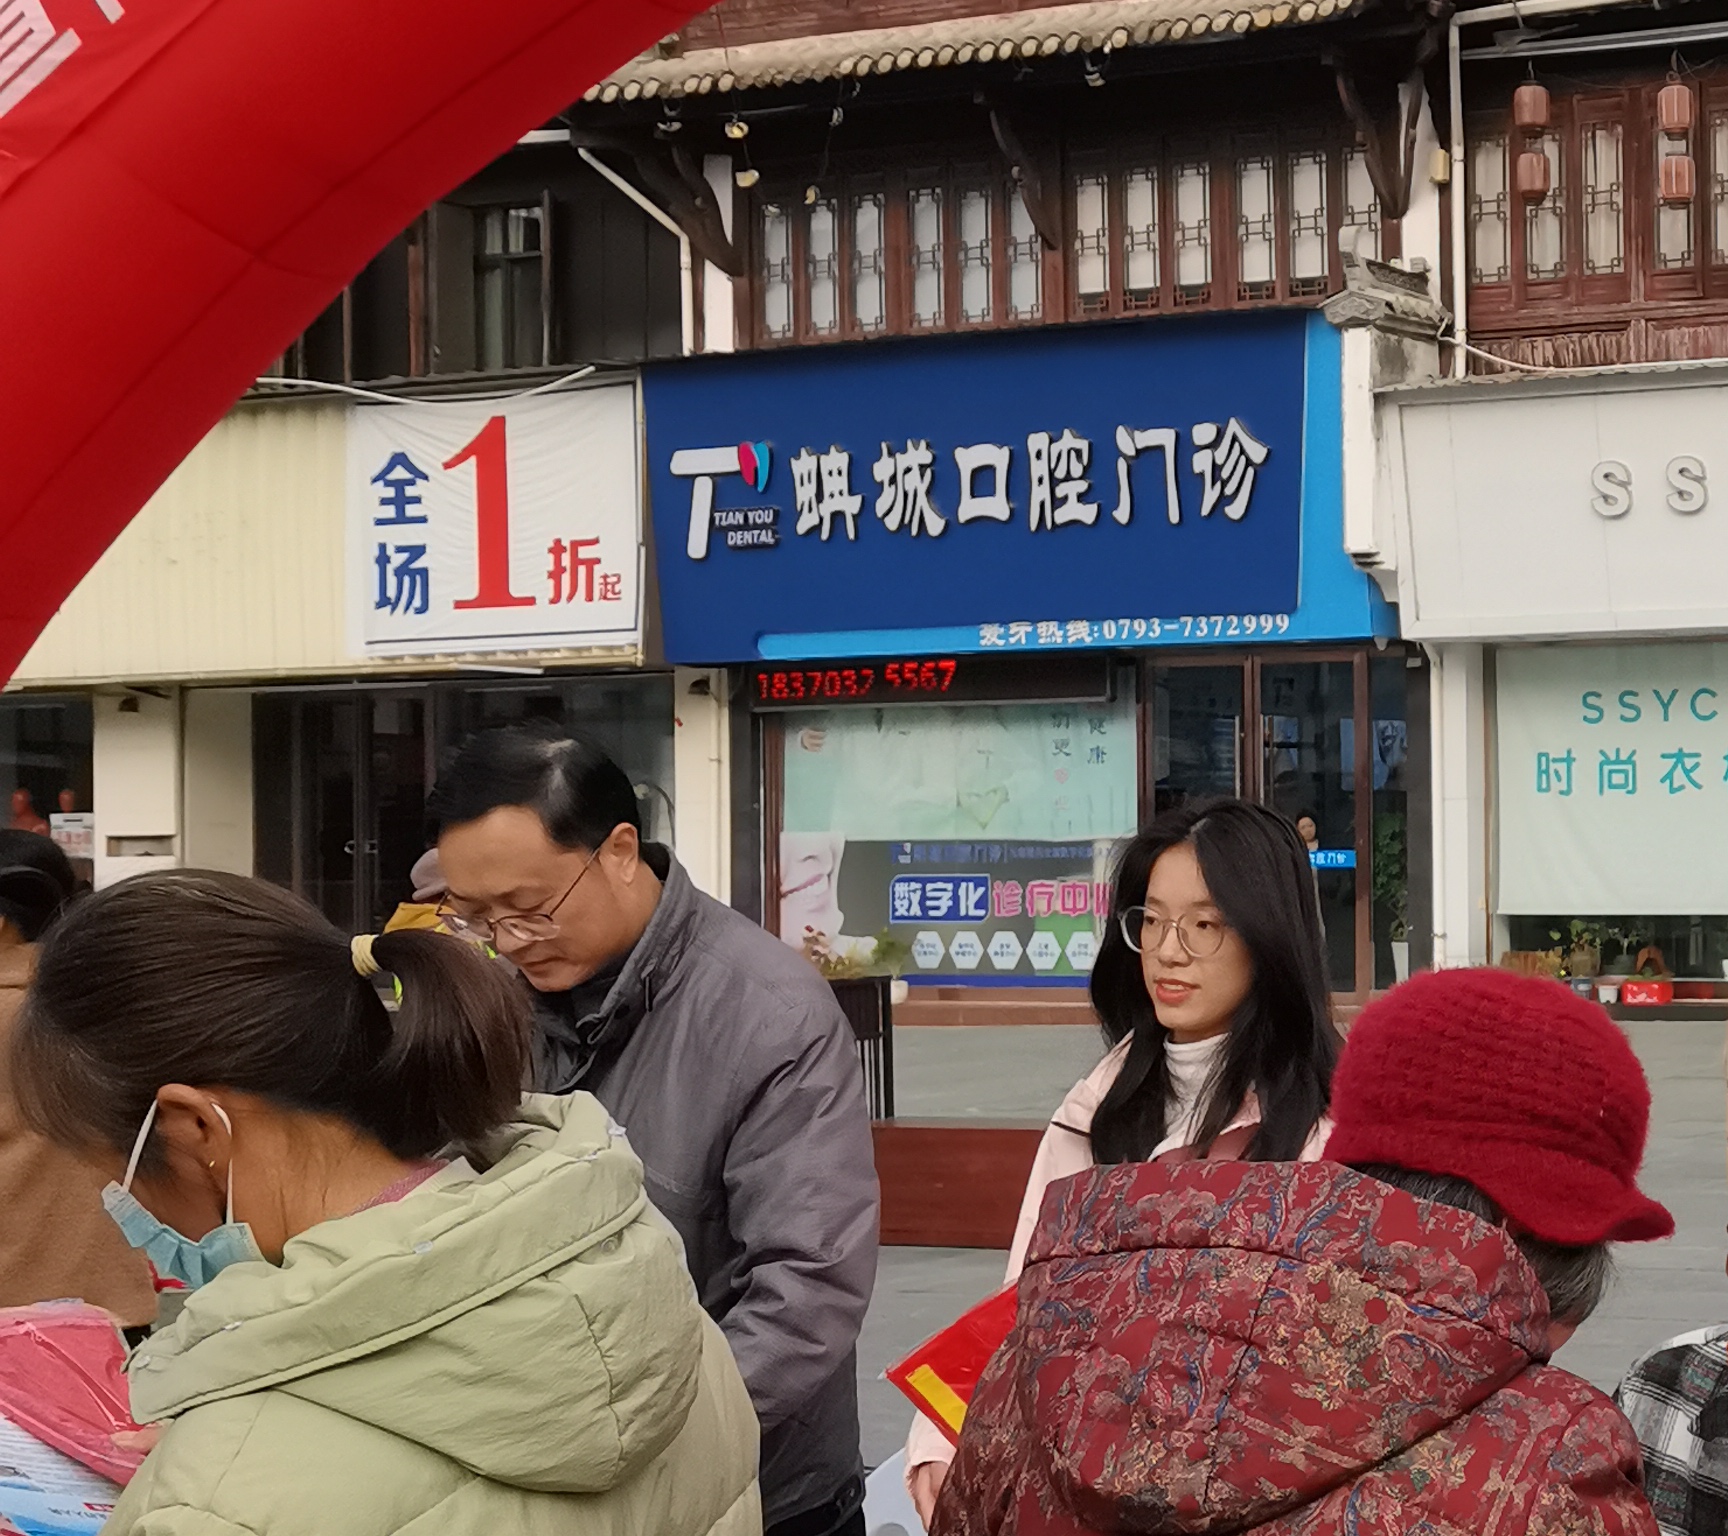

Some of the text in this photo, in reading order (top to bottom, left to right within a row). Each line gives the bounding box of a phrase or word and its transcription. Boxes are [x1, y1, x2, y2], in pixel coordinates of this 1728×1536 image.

[370, 451, 430, 615] 全场
[714, 508, 774, 528] TIAN YOU
[727, 528, 776, 546] DENTAL
[1580, 686, 1720, 726] SSYC
